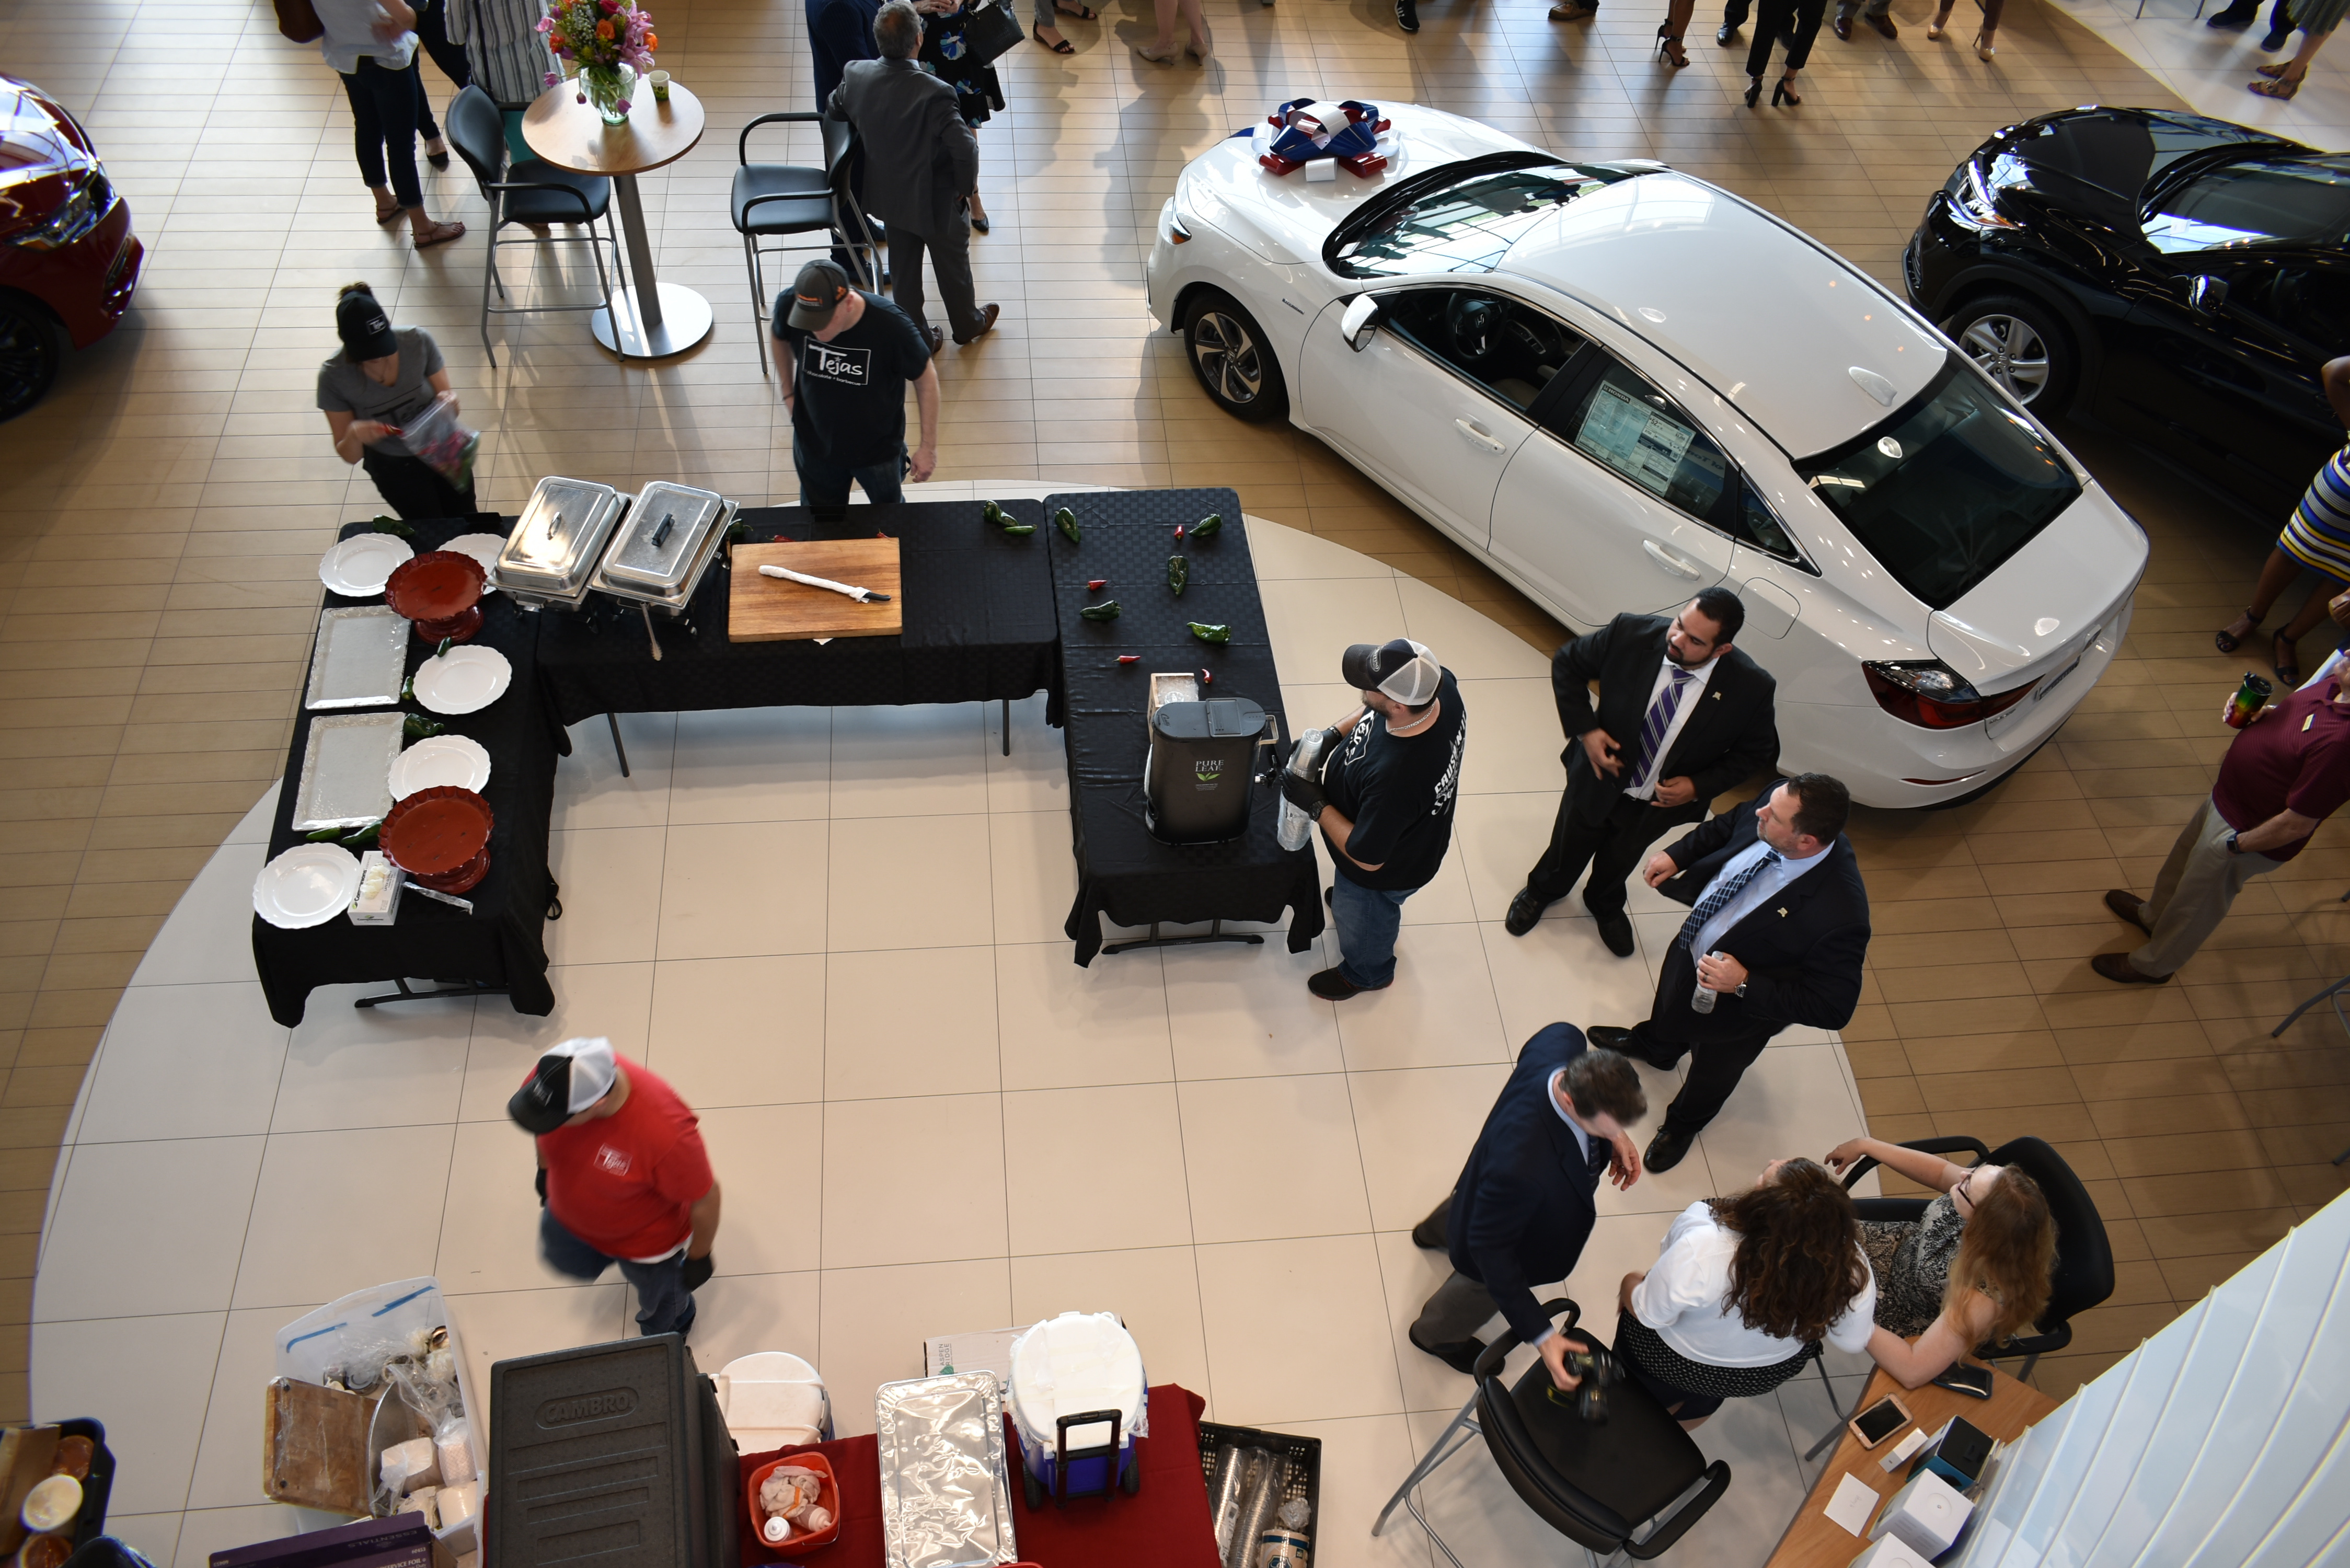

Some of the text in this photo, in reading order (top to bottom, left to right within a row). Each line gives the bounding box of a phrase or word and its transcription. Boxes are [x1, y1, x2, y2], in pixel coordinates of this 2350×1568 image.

[808, 344, 863, 375] Tejas
[1608, 388, 1629, 402] HONDA
[545, 1392, 630, 1424] CAMBRO
[348, 1530, 417, 1548] ESSENTIALS
